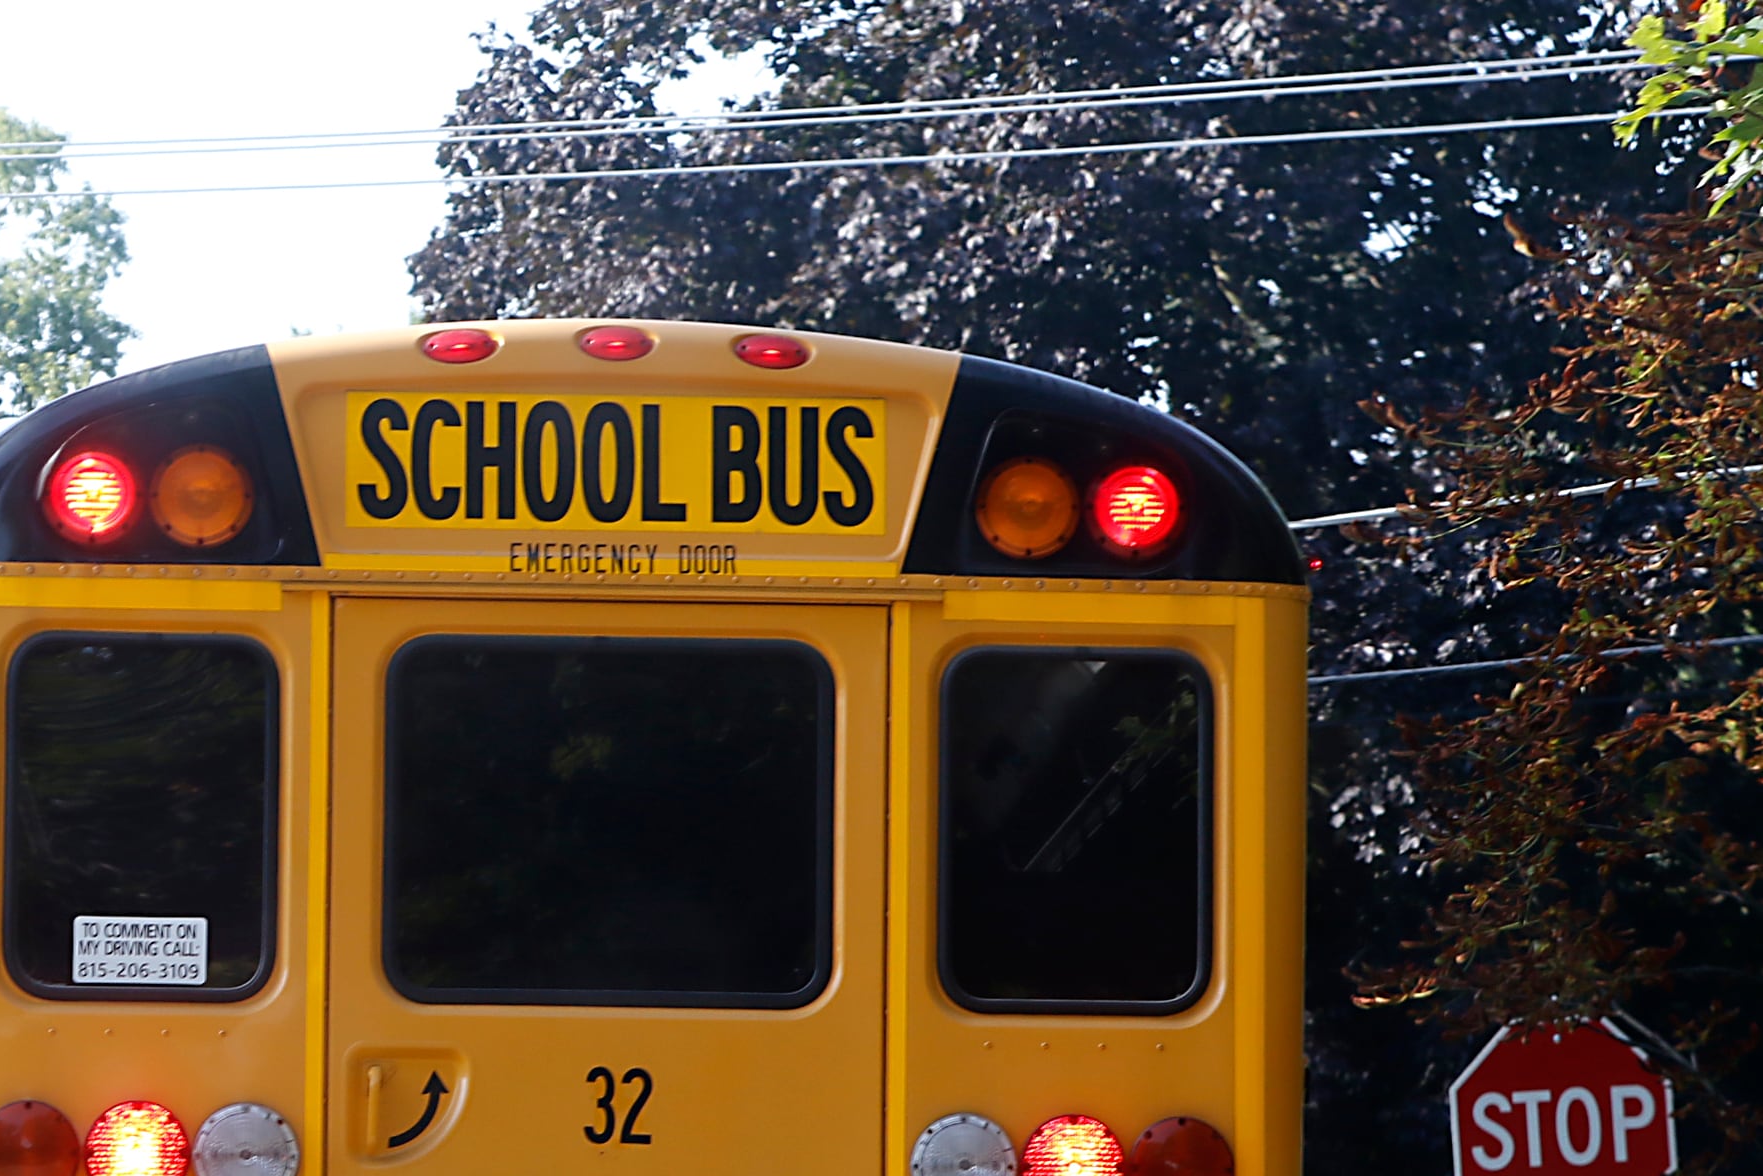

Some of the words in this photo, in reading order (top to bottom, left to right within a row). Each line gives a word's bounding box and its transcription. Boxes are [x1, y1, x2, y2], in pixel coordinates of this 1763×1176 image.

[357, 397, 688, 524] SCHOOL
[711, 404, 876, 528] BUS
[510, 543, 658, 574] EMERGENCY
[679, 544, 737, 576] DOOR
[82, 922, 99, 938] TO
[103, 922, 173, 939] COMMENT
[176, 923, 197, 940] ON
[78, 940, 100, 956] MY
[104, 940, 158, 957] DRIVING
[77, 962, 199, 979] 815-206-3109
[583, 1066, 652, 1144] 32
[1470, 1084, 1656, 1172] STOP
